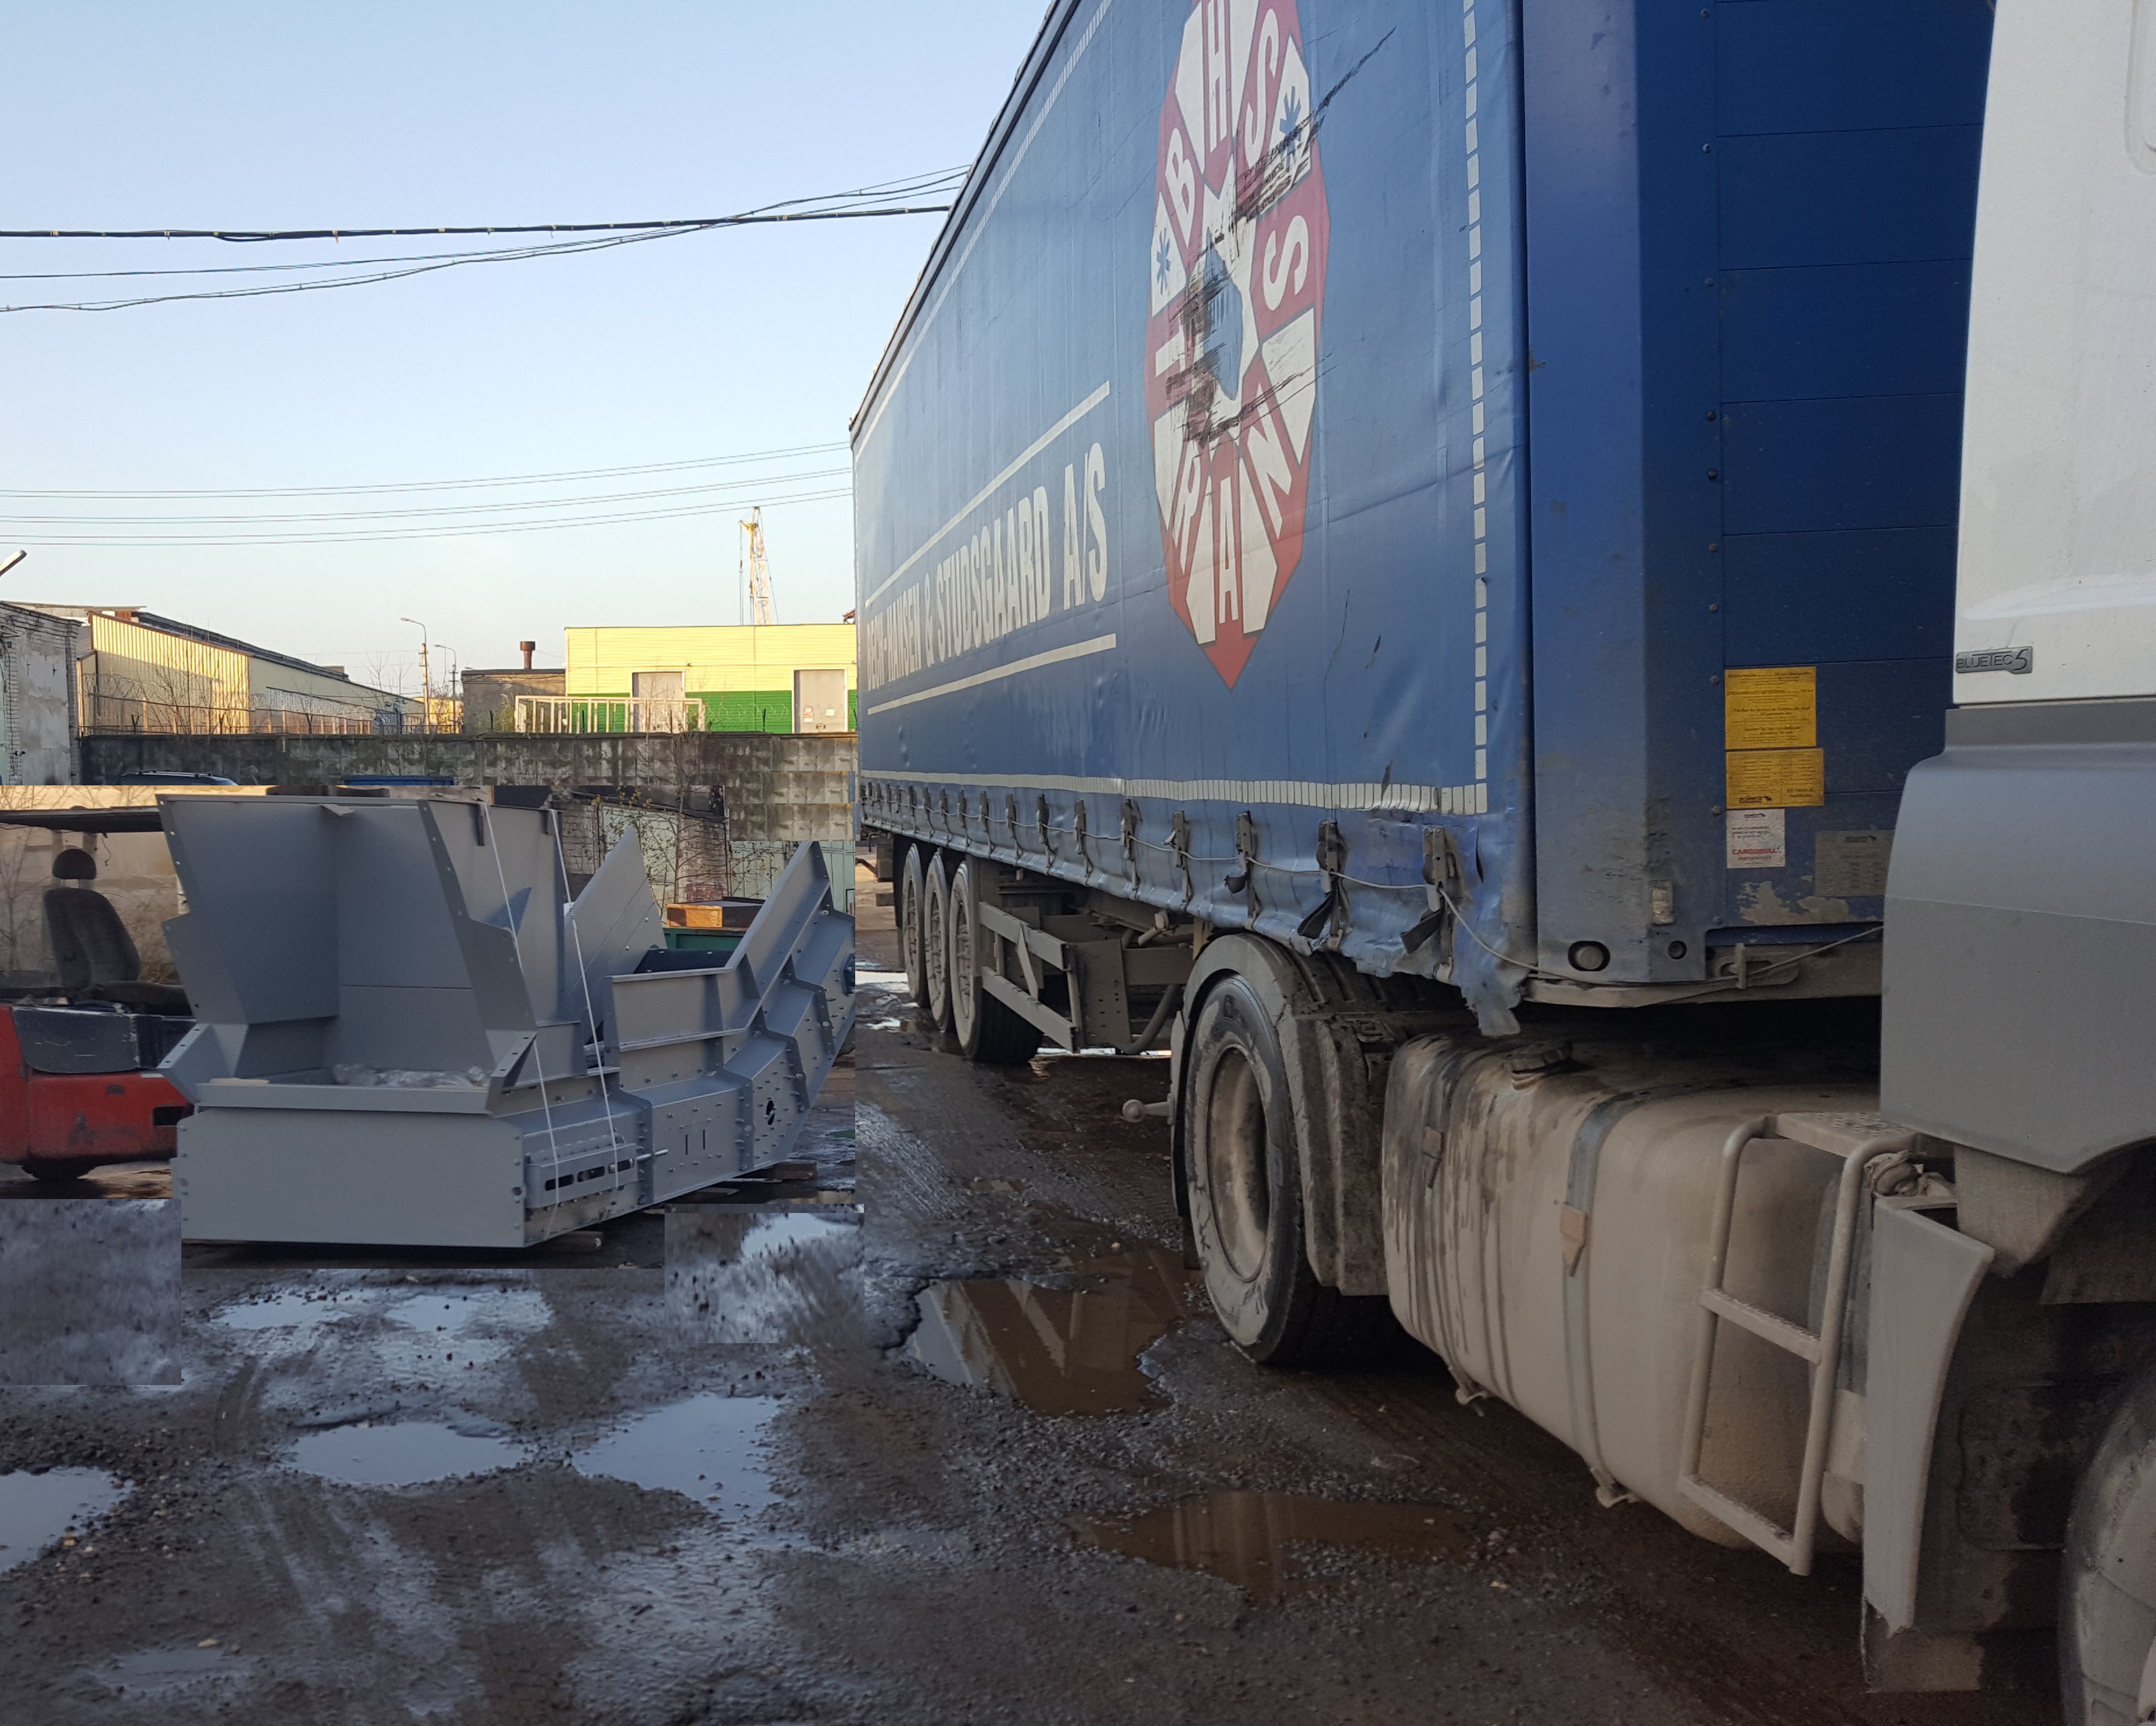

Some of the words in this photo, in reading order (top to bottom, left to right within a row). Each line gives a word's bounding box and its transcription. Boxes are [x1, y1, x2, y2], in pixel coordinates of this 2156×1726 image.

[924, 573, 935, 668] &
[935, 486, 1050, 663] STUDSGAARD
[1064, 443, 1107, 610] A/S
